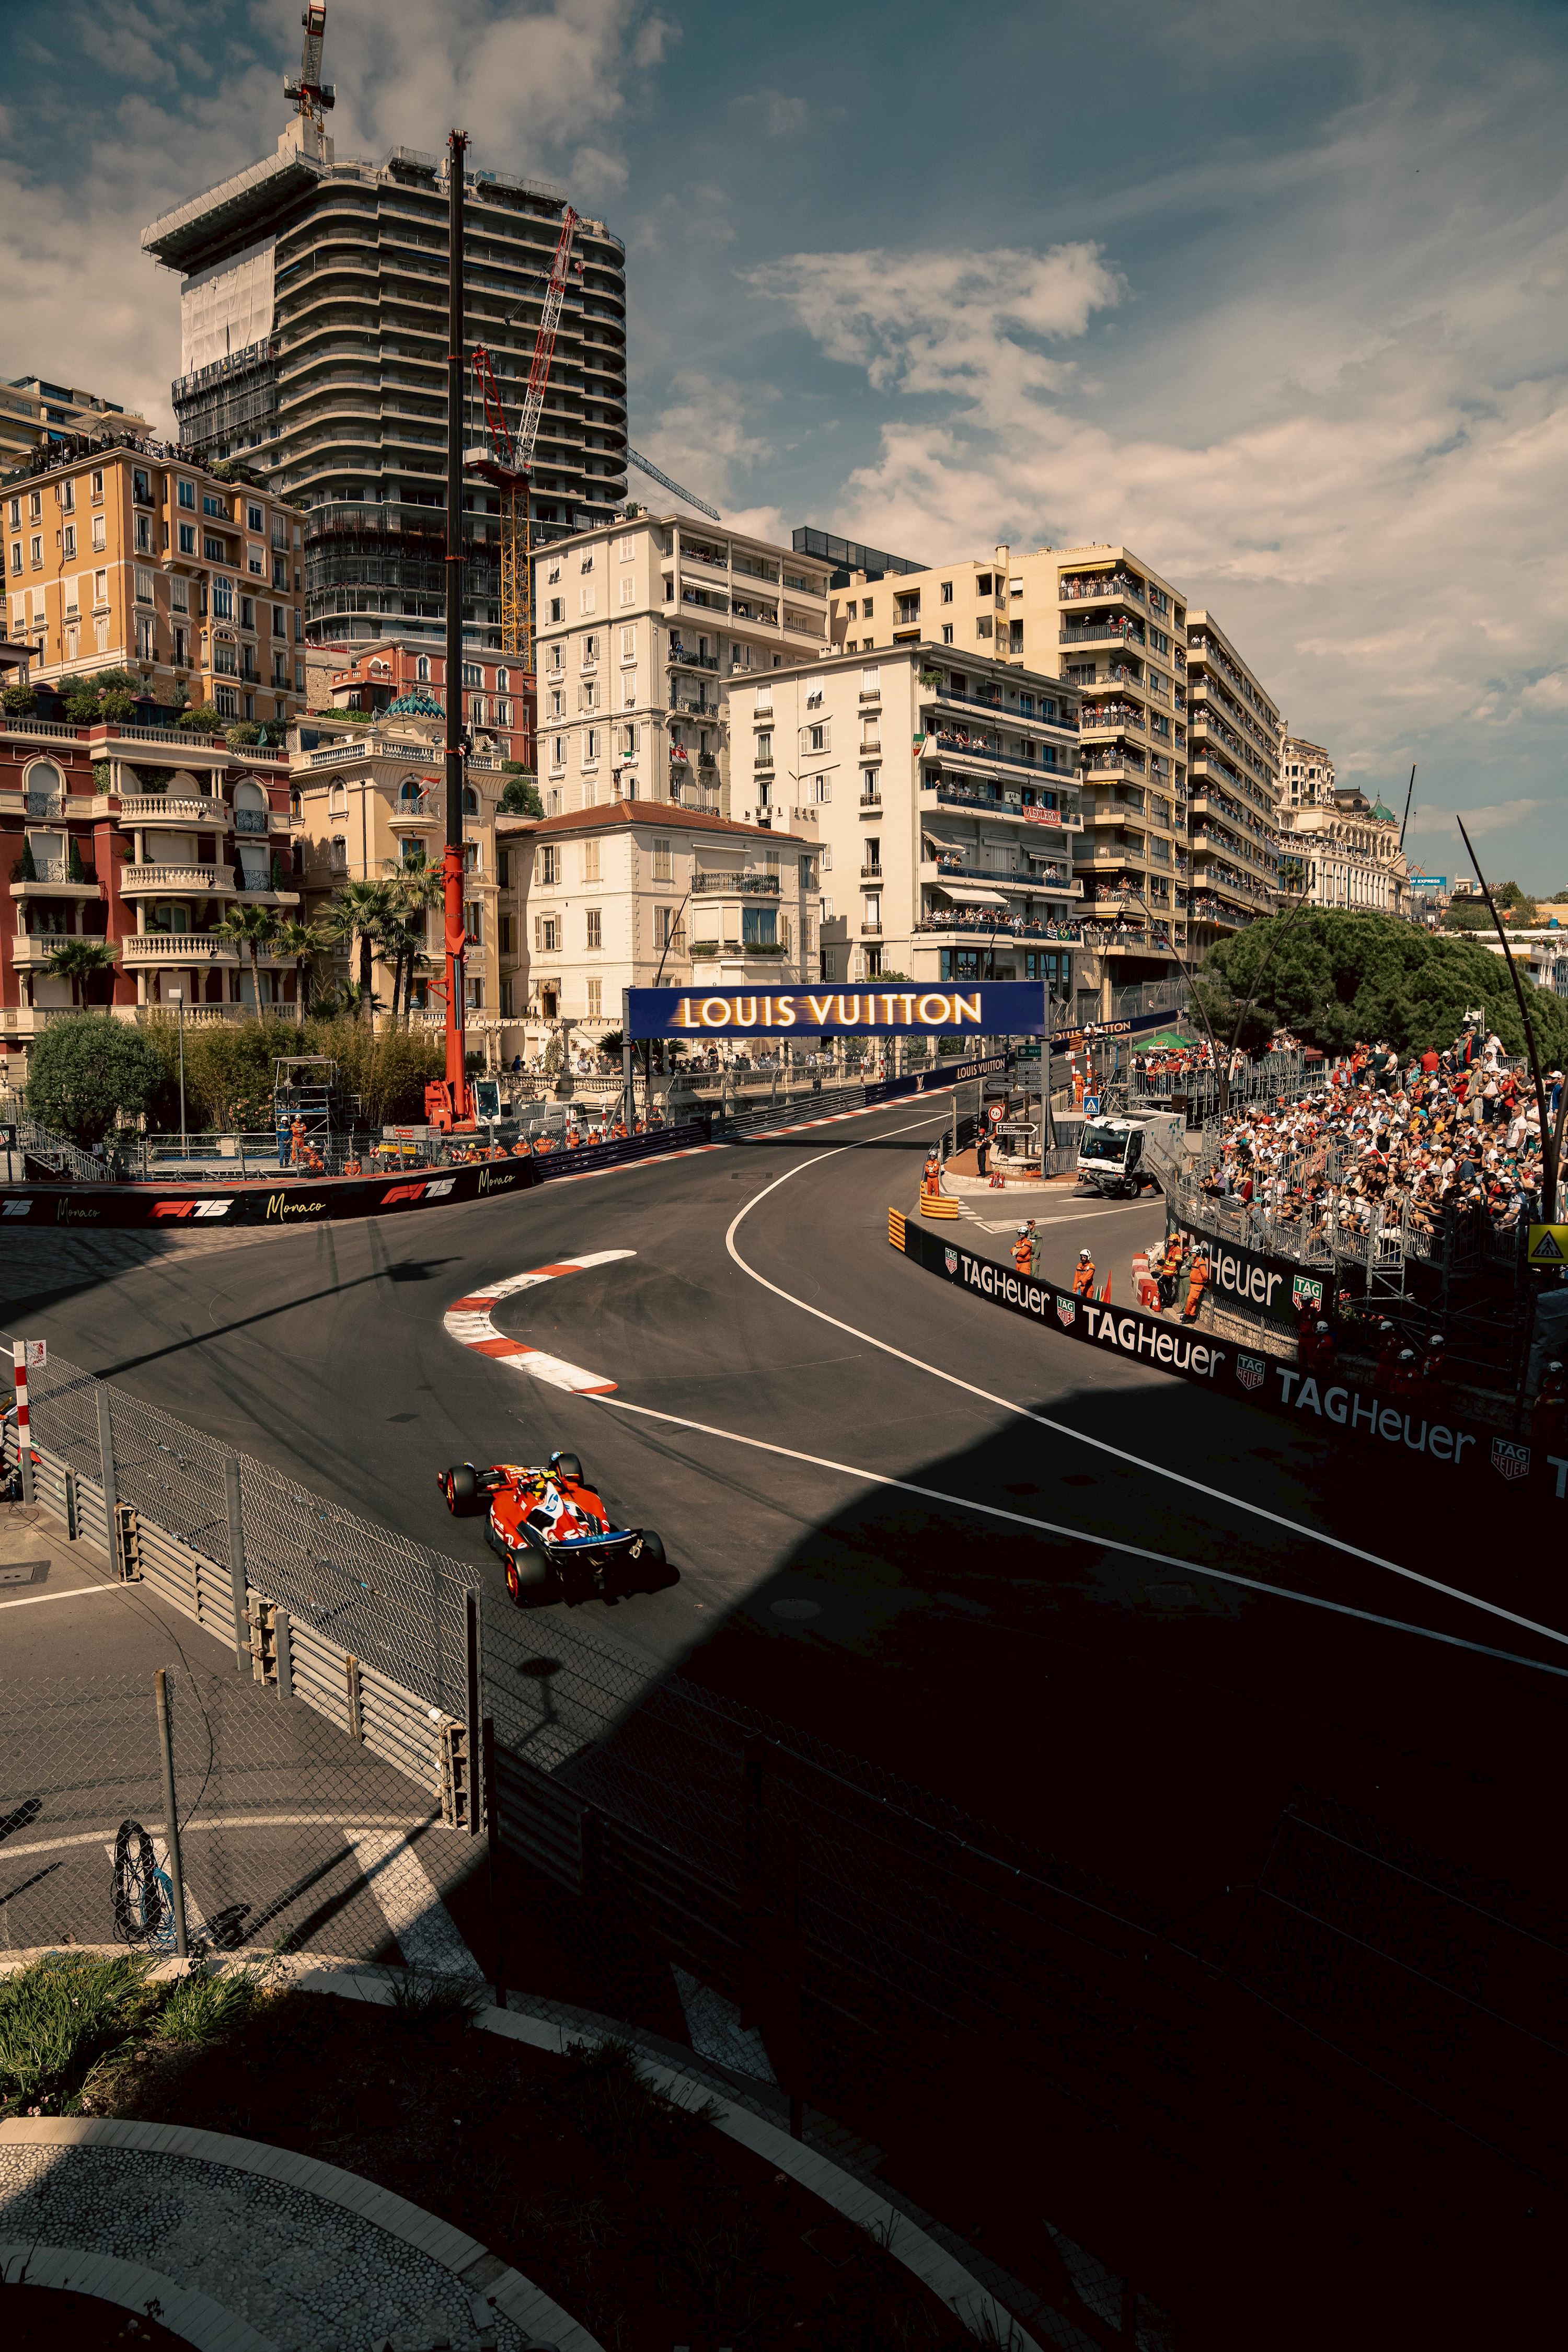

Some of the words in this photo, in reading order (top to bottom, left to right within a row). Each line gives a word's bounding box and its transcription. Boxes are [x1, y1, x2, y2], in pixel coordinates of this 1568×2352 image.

[1029, 808, 1055, 822] LECLERC
[684, 996, 795, 1027] LOUIS
[808, 993, 982, 1025] VUITTON
[957, 1065, 977, 1079] LOUIS
[978, 1058, 1005, 1074] VUITTON
[478, 1168, 515, 1193] Monaco
[57, 1197, 100, 1224] Monaco
[267, 1193, 326, 1221] Monaco
[947, 1250, 956, 1261] TAG
[1296, 1279, 1320, 1299] TAG
[1058, 1298, 1073, 1312] TAG
[1058, 1309, 1074, 1324] HEUER
[1240, 1357, 1262, 1373] TAG
[1238, 1369, 1262, 1387] HEUER
[1496, 1441, 1526, 1461] TAG
[1494, 1455, 1527, 1477] HEUER
